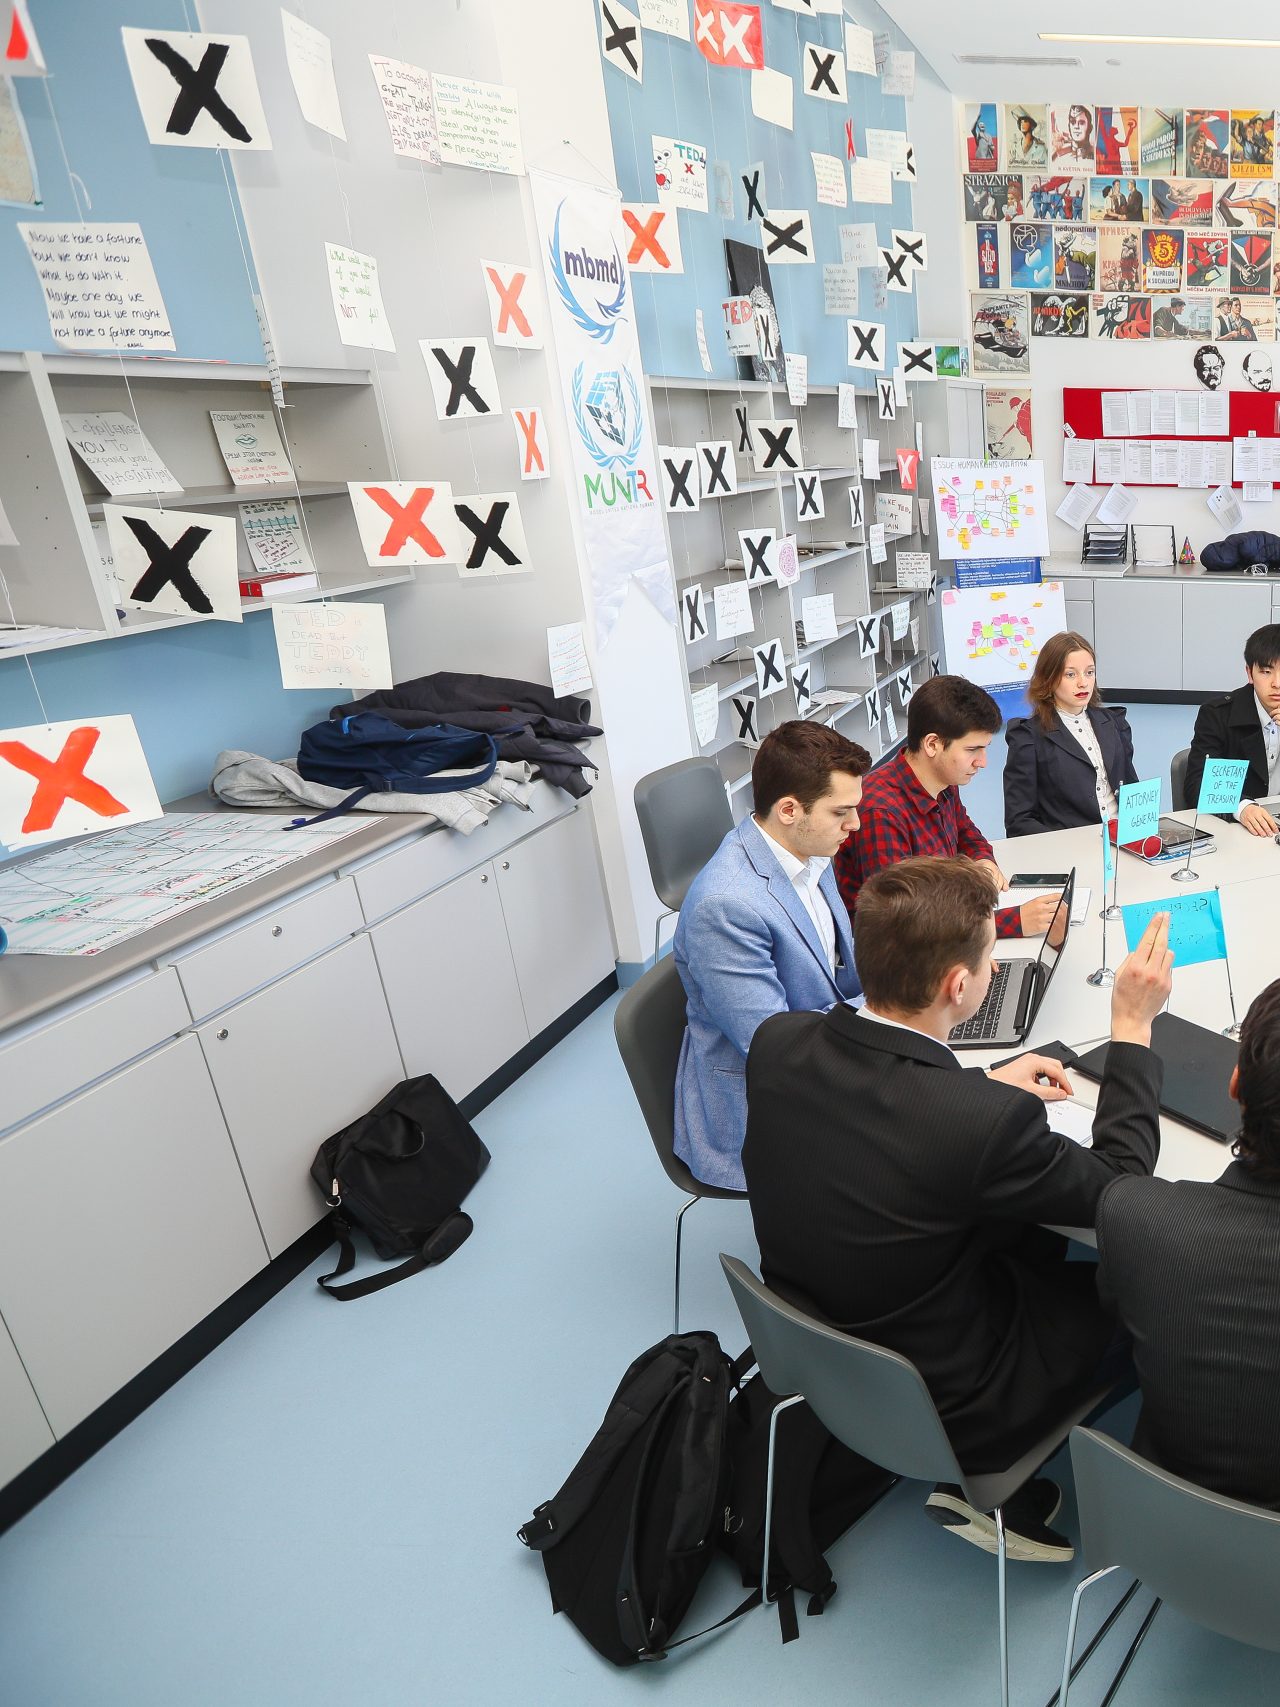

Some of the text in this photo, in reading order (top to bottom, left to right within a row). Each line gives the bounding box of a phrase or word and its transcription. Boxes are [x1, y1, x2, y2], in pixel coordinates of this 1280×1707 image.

[29, 231, 54, 243] Now
[73, 232, 93, 243] have
[96, 234, 103, 243] a
[106, 233, 143, 245] fortune
[32, 249, 53, 261] but
[76, 252, 98, 262] don't
[104, 252, 130, 262] know
[564, 246, 620, 286] mbmd
[65, 270, 74, 281] to
[78, 270, 89, 280] do
[92, 270, 112, 281] with
[46, 288, 144, 305] Maybe one day we
[68, 309, 90, 319] know
[94, 309, 111, 318] but
[115, 310, 127, 318] we
[132, 308, 160, 320] might
[722, 300, 753, 325] TED
[54, 327, 69, 337] not
[73, 327, 95, 337] have
[98, 327, 105, 336] a
[109, 327, 135, 342] fortune
[583, 469, 654, 509] MUNTR
[282, 609, 345, 627] TED
[284, 641, 368, 661] TEDDY
[1211, 764, 1247, 781] SECRETARY
[1213, 780, 1238, 790] OF THE
[1125, 788, 1160, 809] ATTORNEY
[1206, 791, 1239, 807] TREASURY
[1130, 811, 1159, 828] GENERAL
